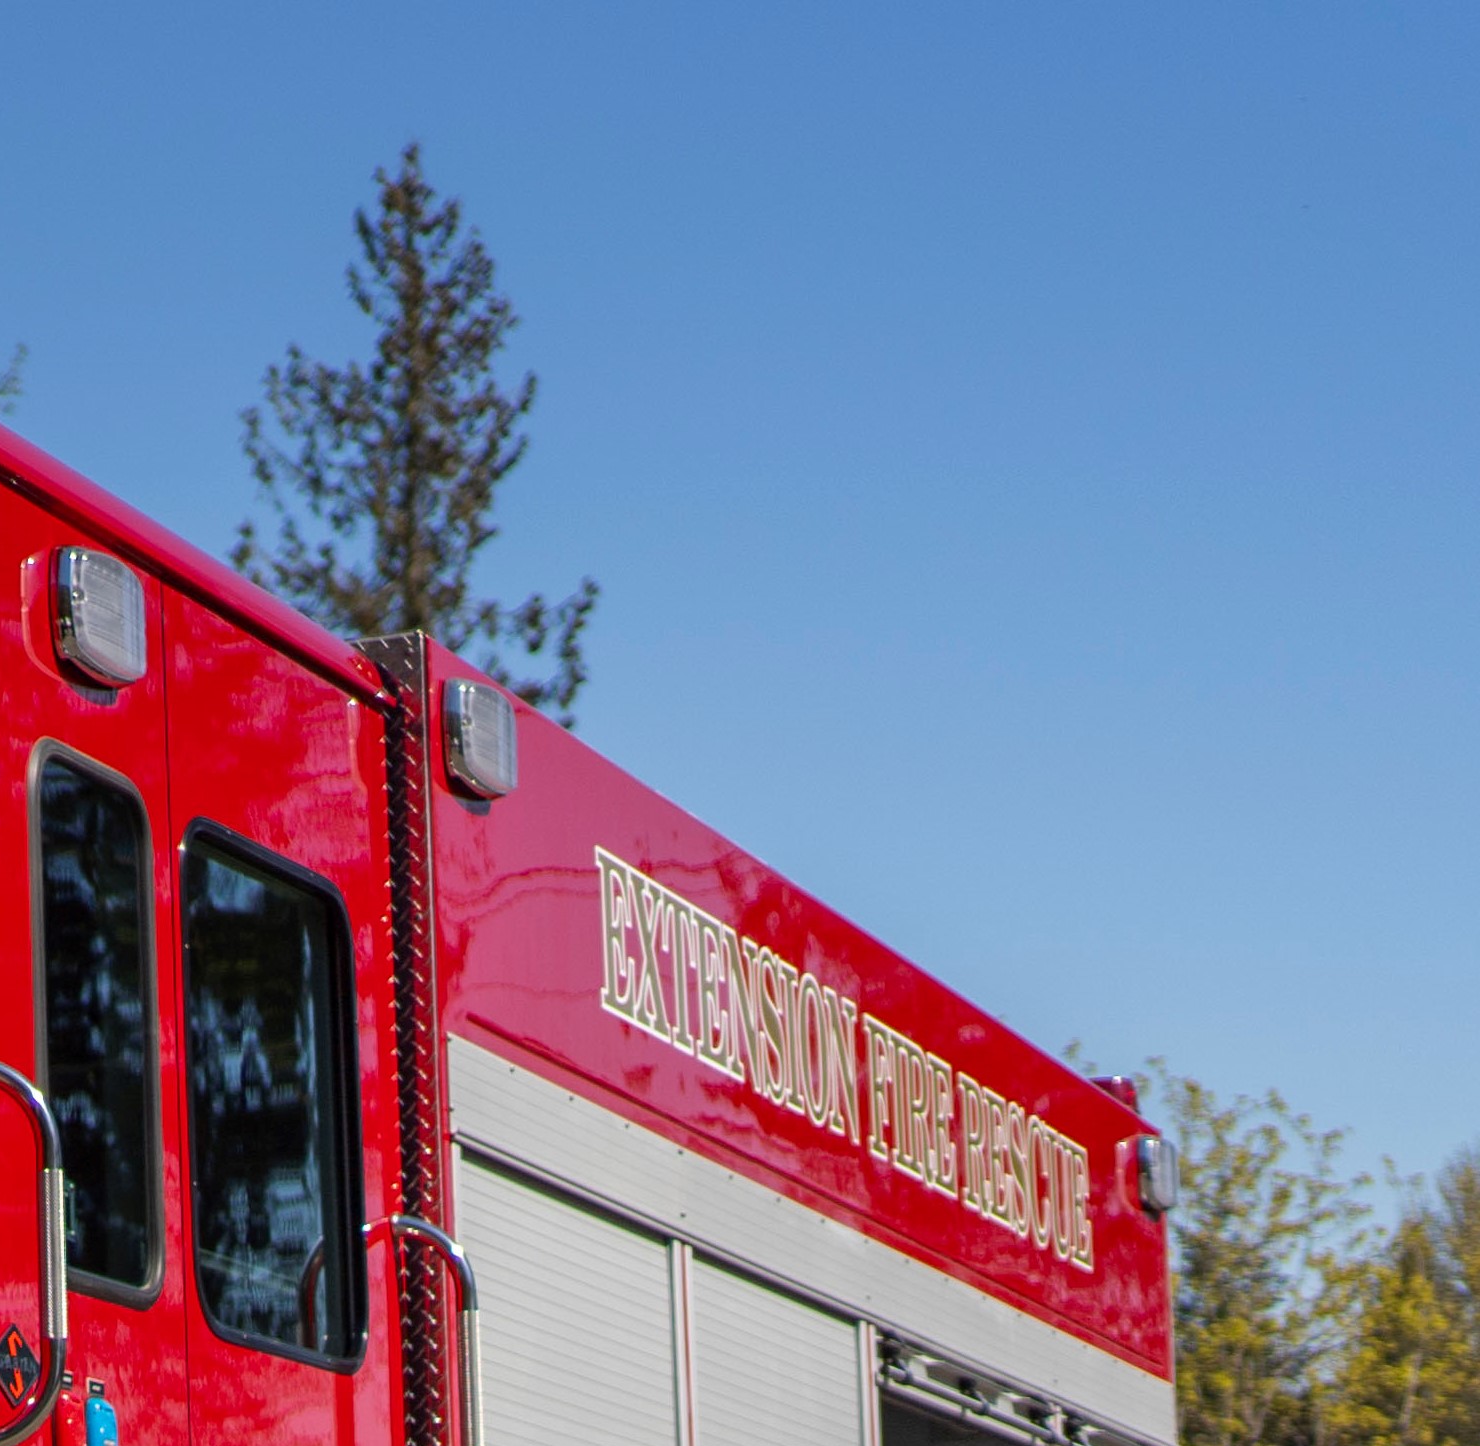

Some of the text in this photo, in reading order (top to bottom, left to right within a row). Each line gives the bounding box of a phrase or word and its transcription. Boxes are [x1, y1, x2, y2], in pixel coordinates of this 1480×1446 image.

[595, 845, 1094, 1272] EXTENSION FIRE RESCUE
